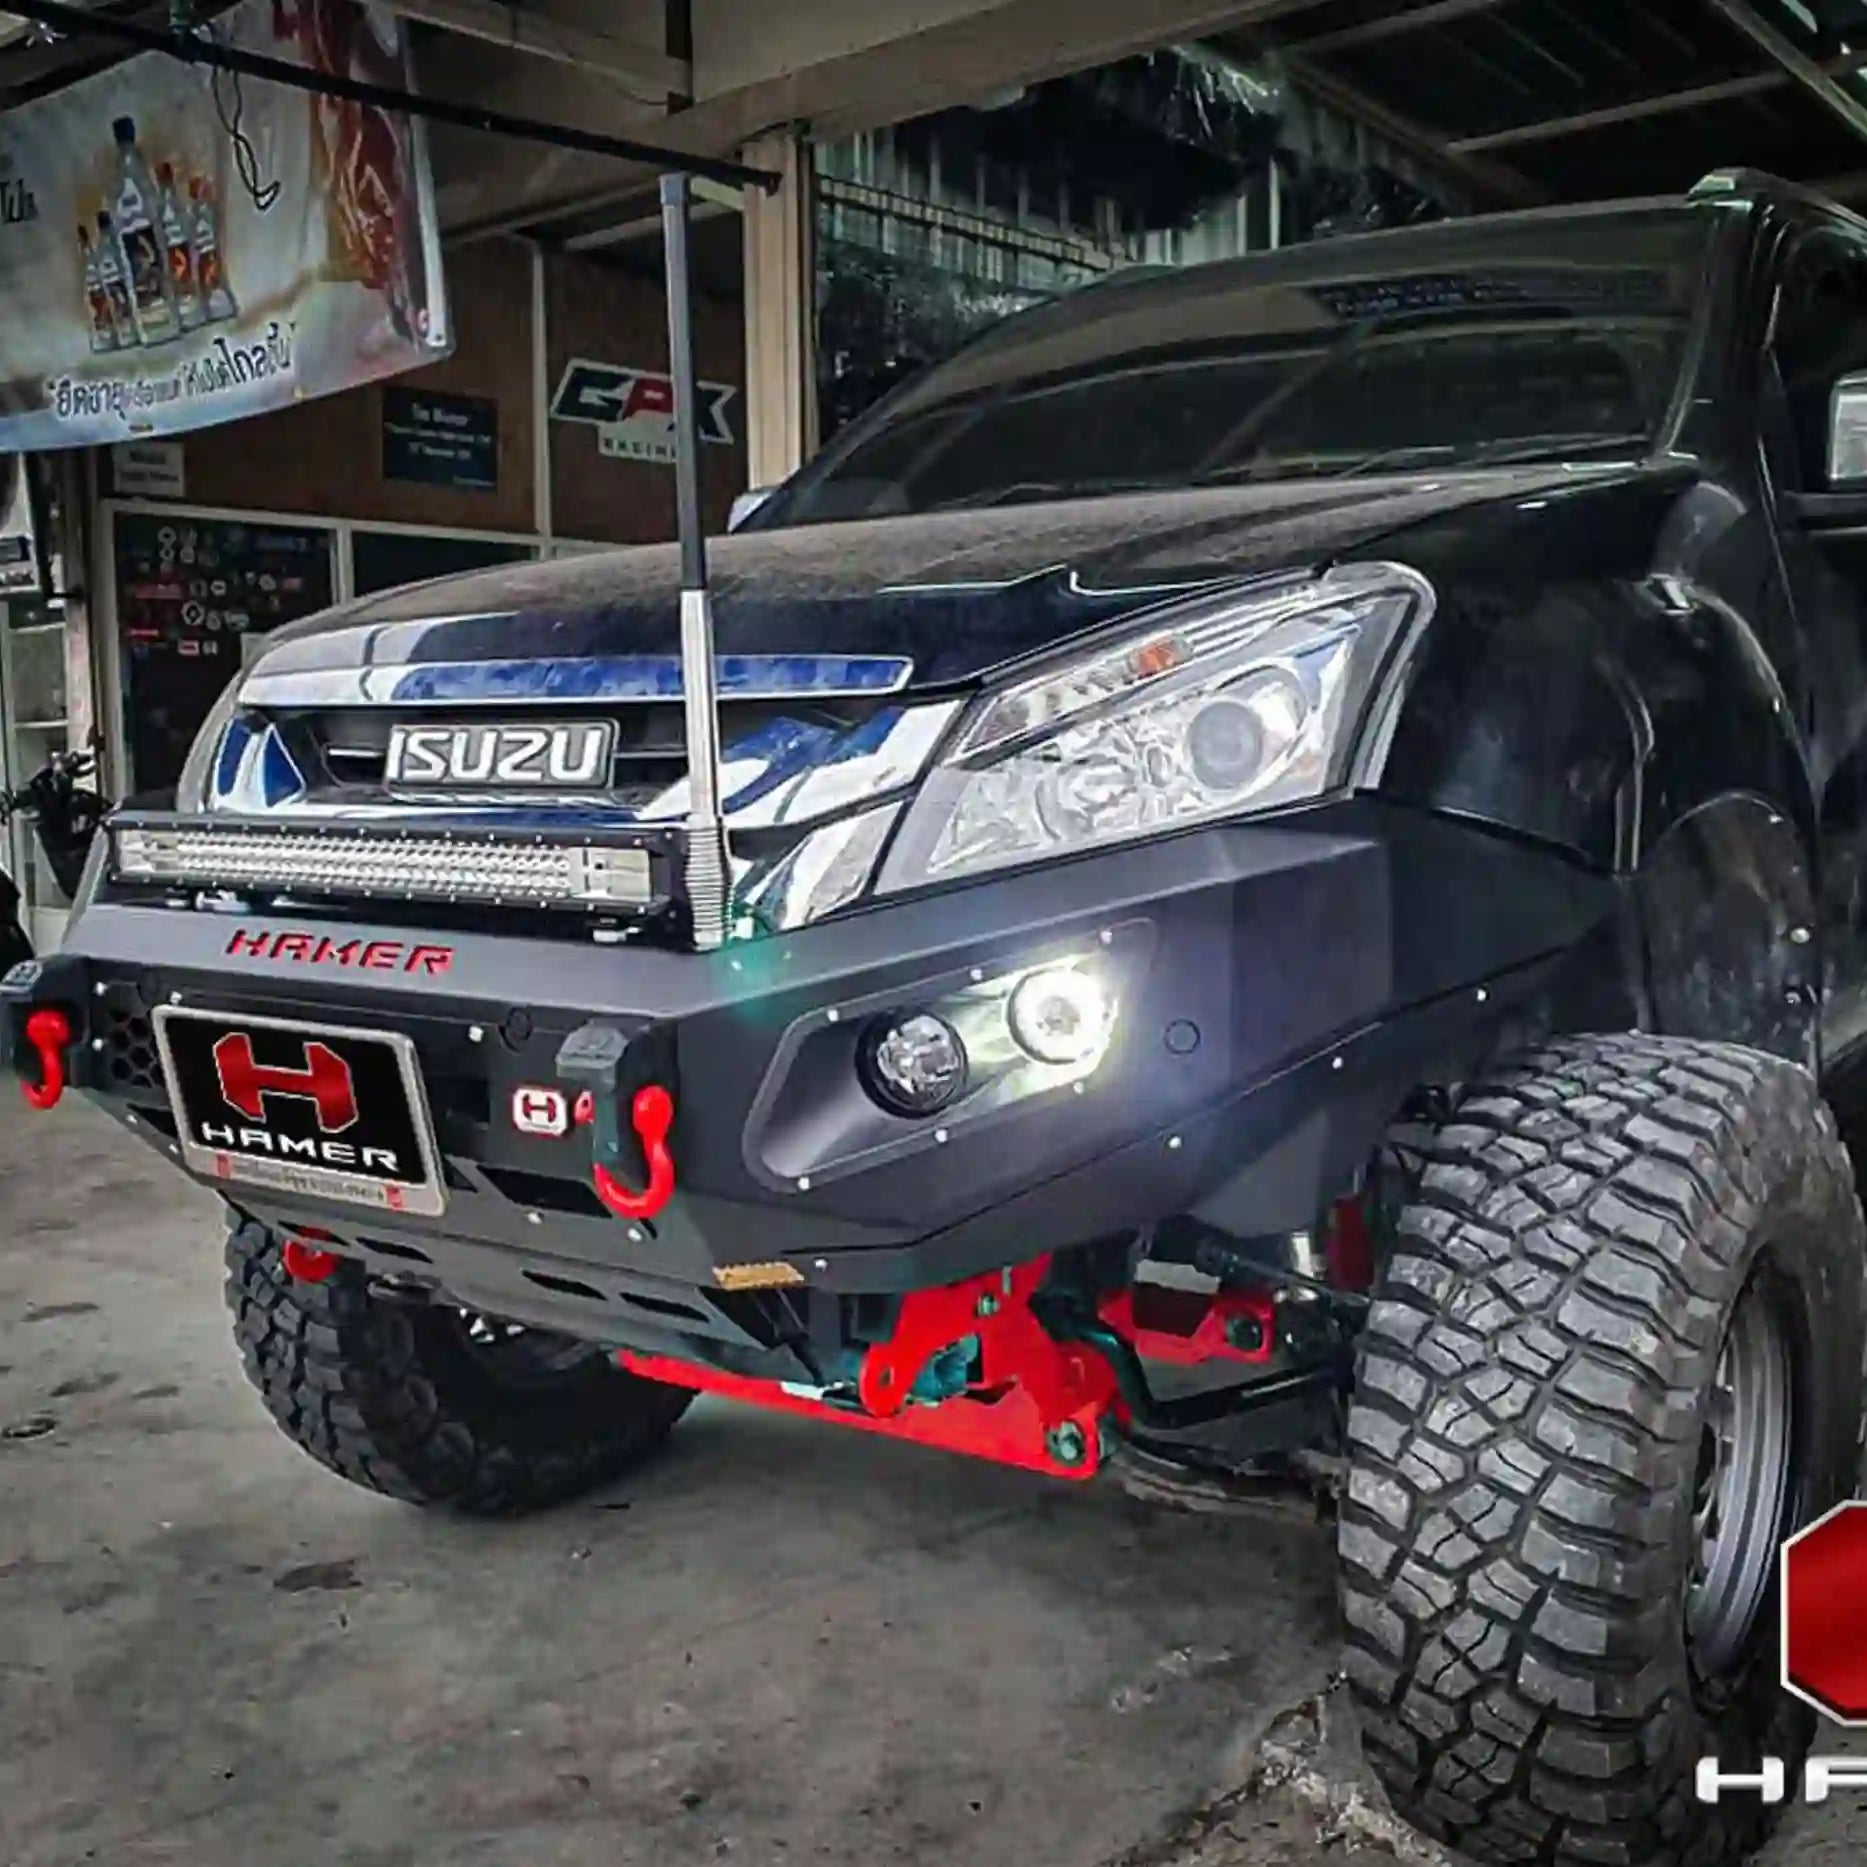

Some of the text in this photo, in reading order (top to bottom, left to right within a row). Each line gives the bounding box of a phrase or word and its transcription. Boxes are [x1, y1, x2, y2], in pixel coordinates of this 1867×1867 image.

[387, 724, 603, 786] ISUZU
[226, 928, 456, 974] HAMER
[201, 1121, 399, 1172] HAMER
